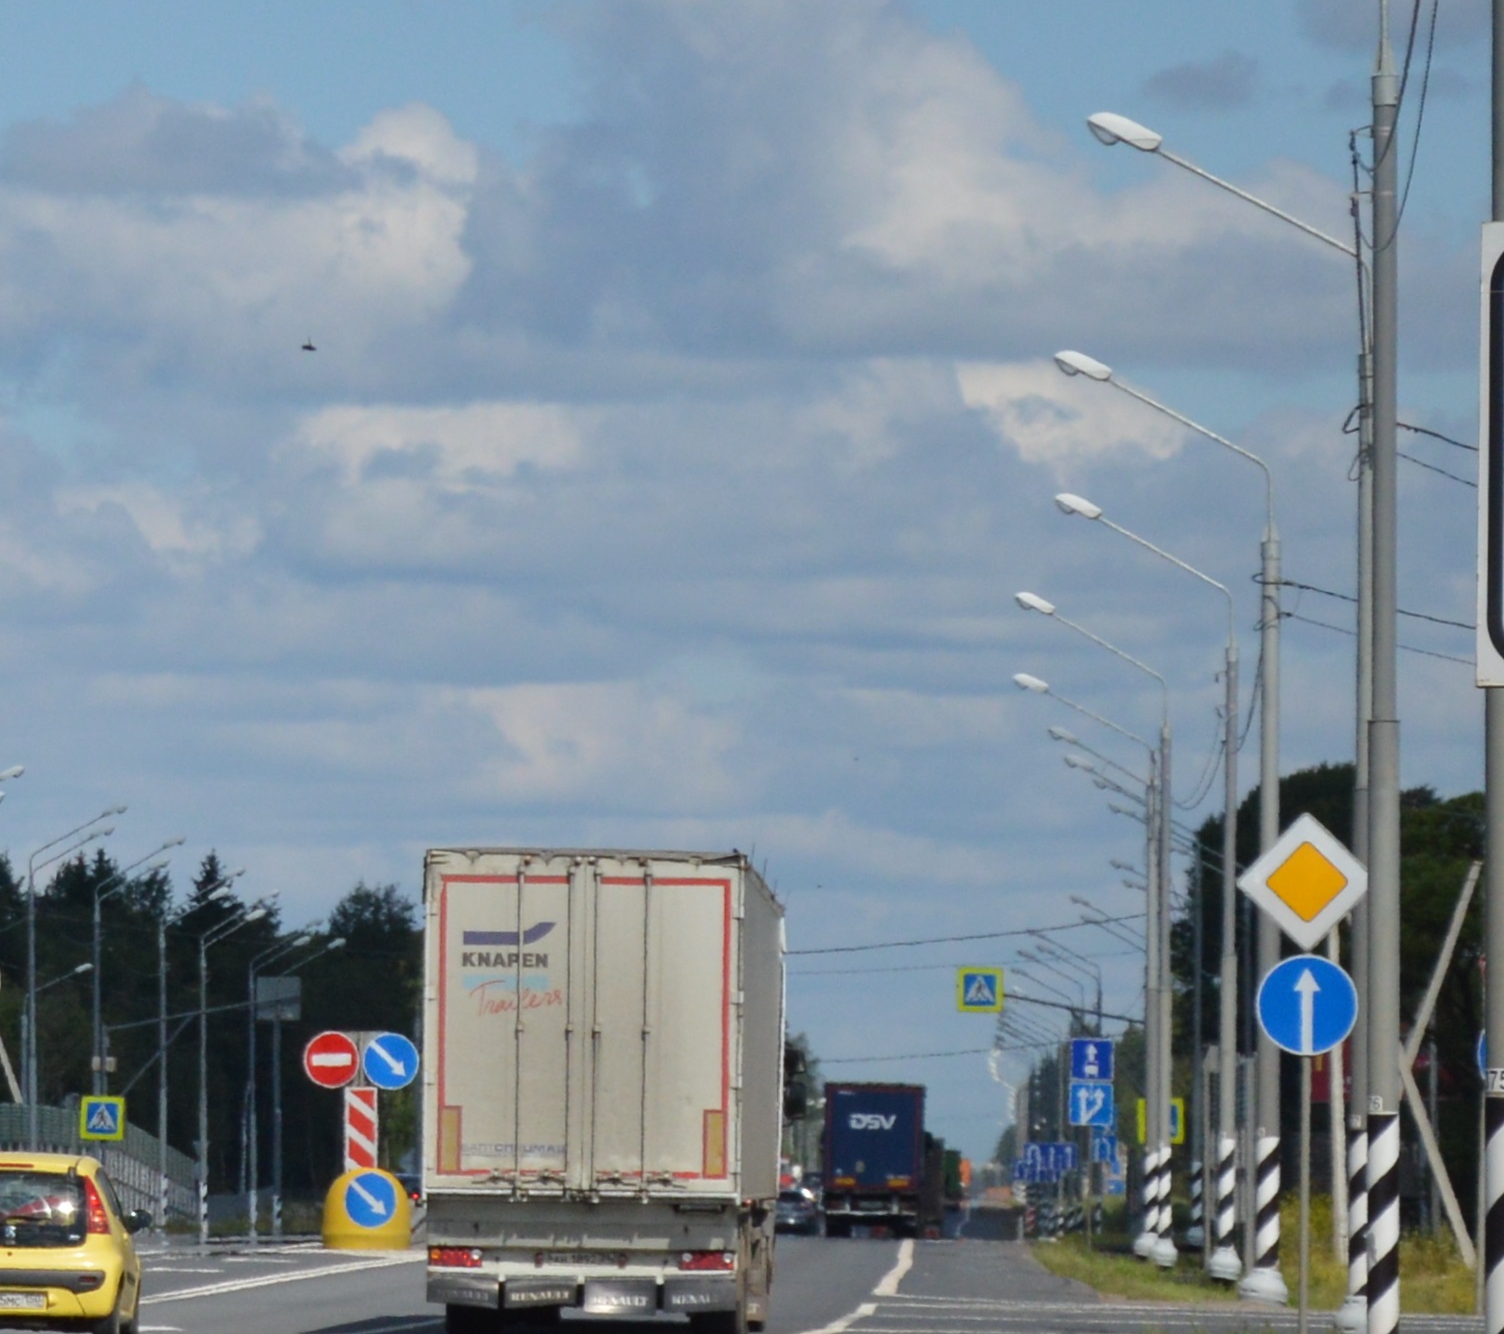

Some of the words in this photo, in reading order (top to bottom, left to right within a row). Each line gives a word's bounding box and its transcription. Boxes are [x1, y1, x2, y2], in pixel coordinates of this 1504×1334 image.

[462, 952, 548, 968] KNAPEN
[849, 1113, 896, 1130] DSV
[510, 1291, 571, 1303] RENAULT
